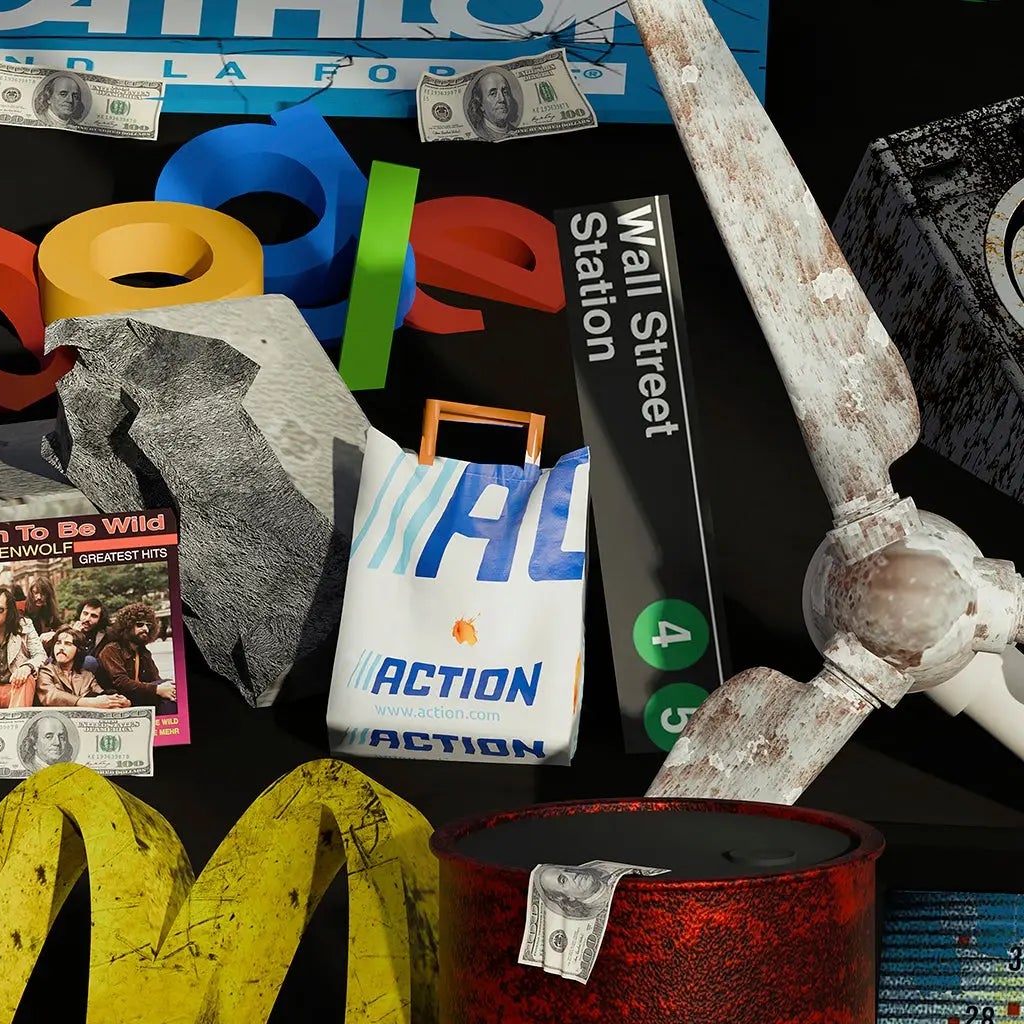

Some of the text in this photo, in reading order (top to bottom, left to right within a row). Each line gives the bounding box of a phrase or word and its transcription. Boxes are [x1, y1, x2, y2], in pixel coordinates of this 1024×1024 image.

[163, 60, 247, 80] LA
[560, 109, 585, 119] 100
[570, 212, 617, 362] Station
[617, 204, 679, 438] Wall Street
[16, 524, 49, 541] To
[58, 520, 96, 538] Be
[102, 514, 165, 533] Wild
[79, 548, 168, 565] GREATEST HITS
[652, 621, 691, 648] 4
[371, 657, 543, 706] ACTION
[375, 704, 501, 721] www.action.com
[660, 707, 701, 733] 5
[369, 729, 546, 759] ACTION
